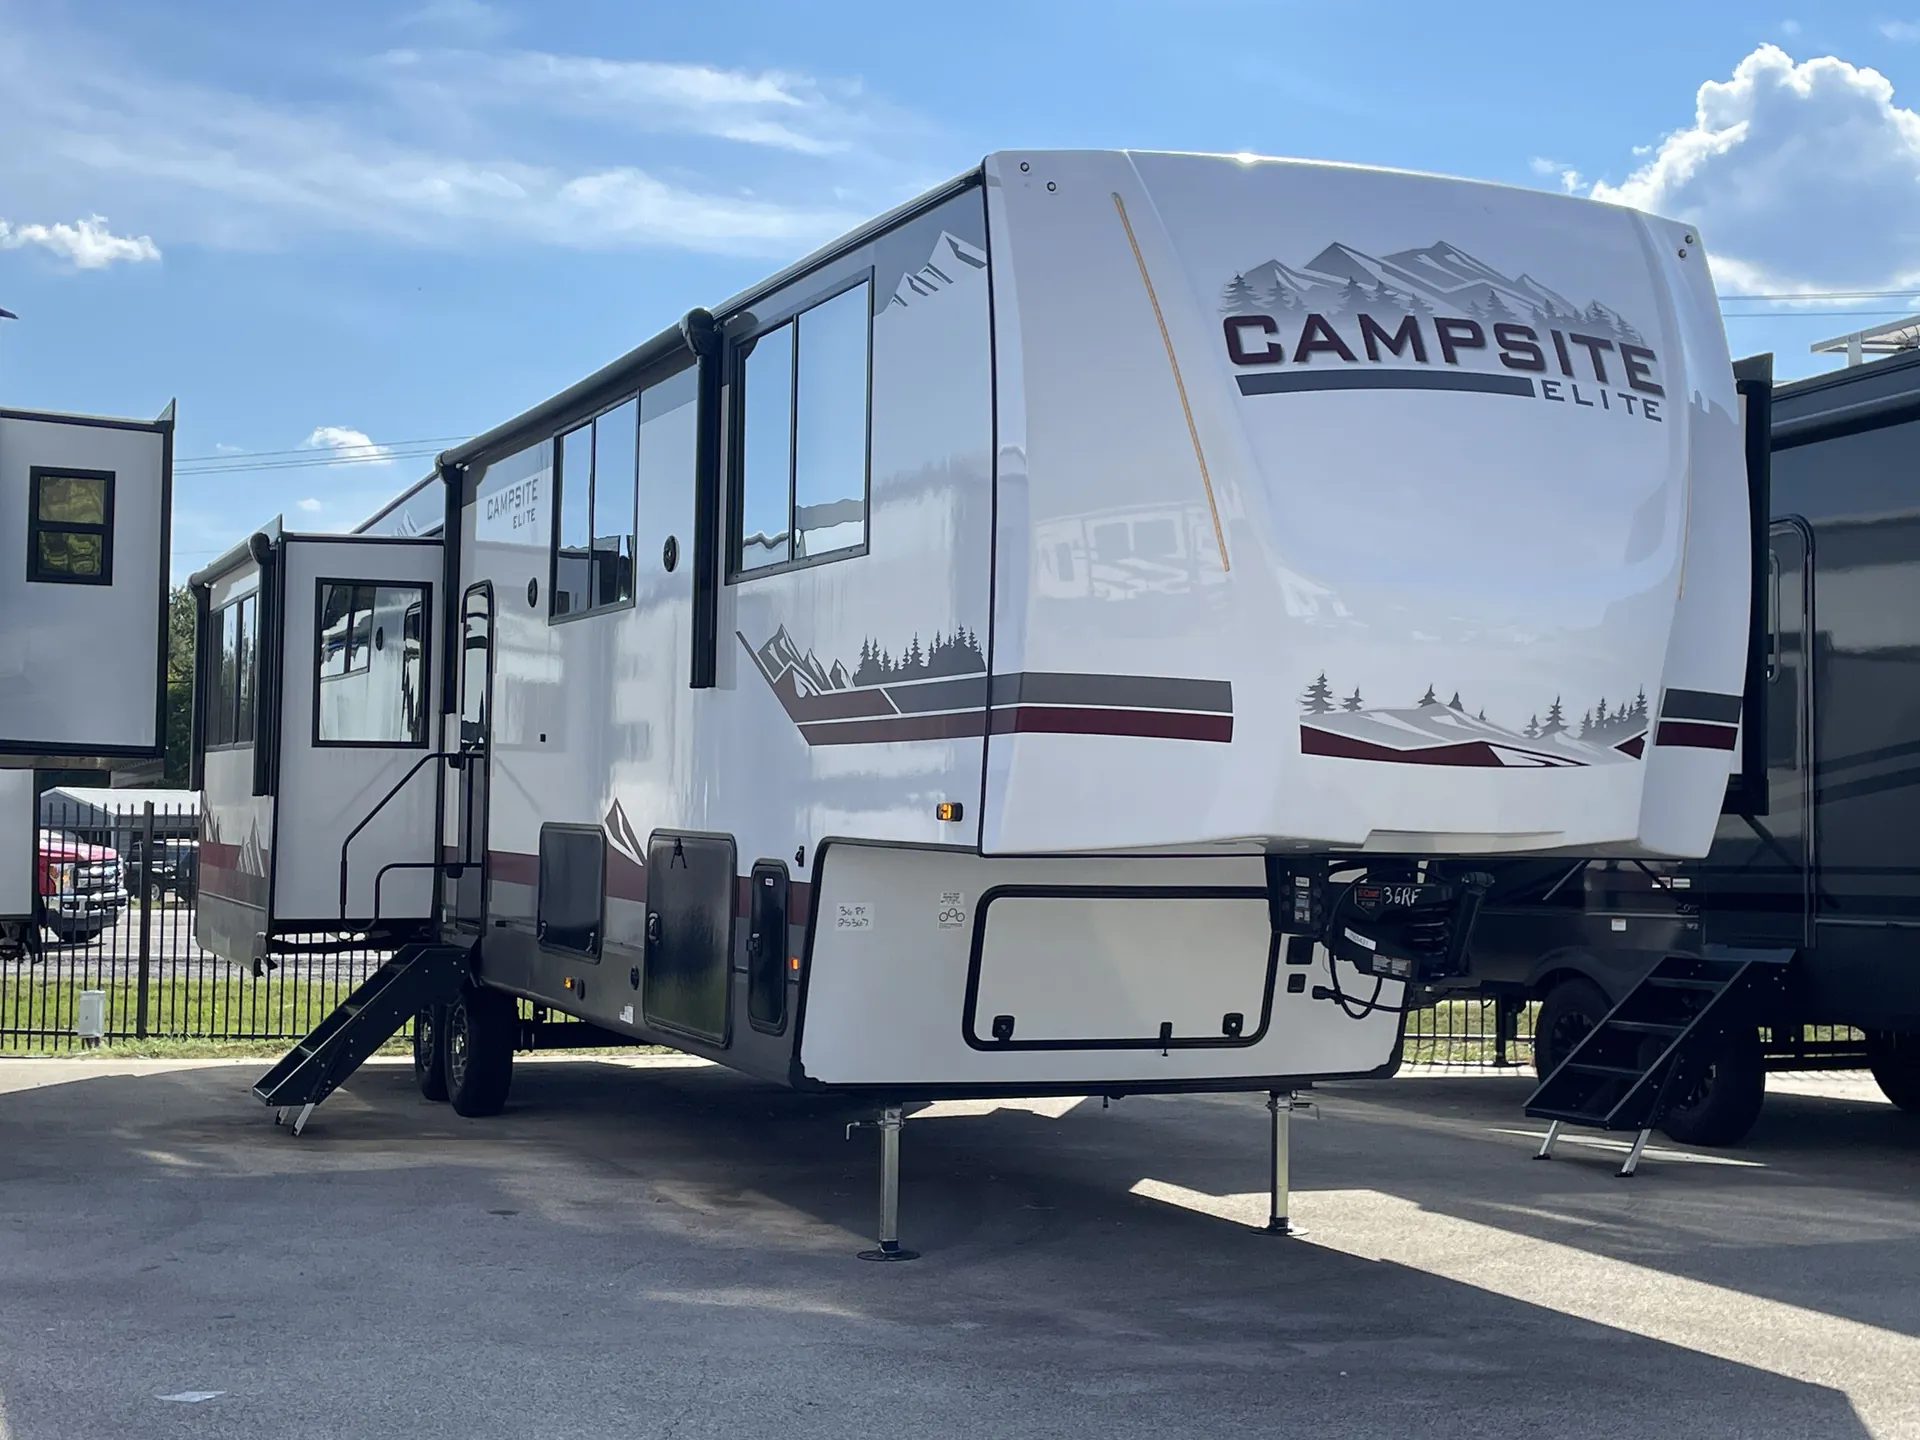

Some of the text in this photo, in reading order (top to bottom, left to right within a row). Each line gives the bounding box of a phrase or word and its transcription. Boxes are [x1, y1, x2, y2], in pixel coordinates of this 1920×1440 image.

[1223, 314, 1664, 397] CAMPSITE
[1541, 379, 1662, 422] ELITE
[487, 479, 538, 520] CAMPSITE
[513, 508, 536, 529] ELITE
